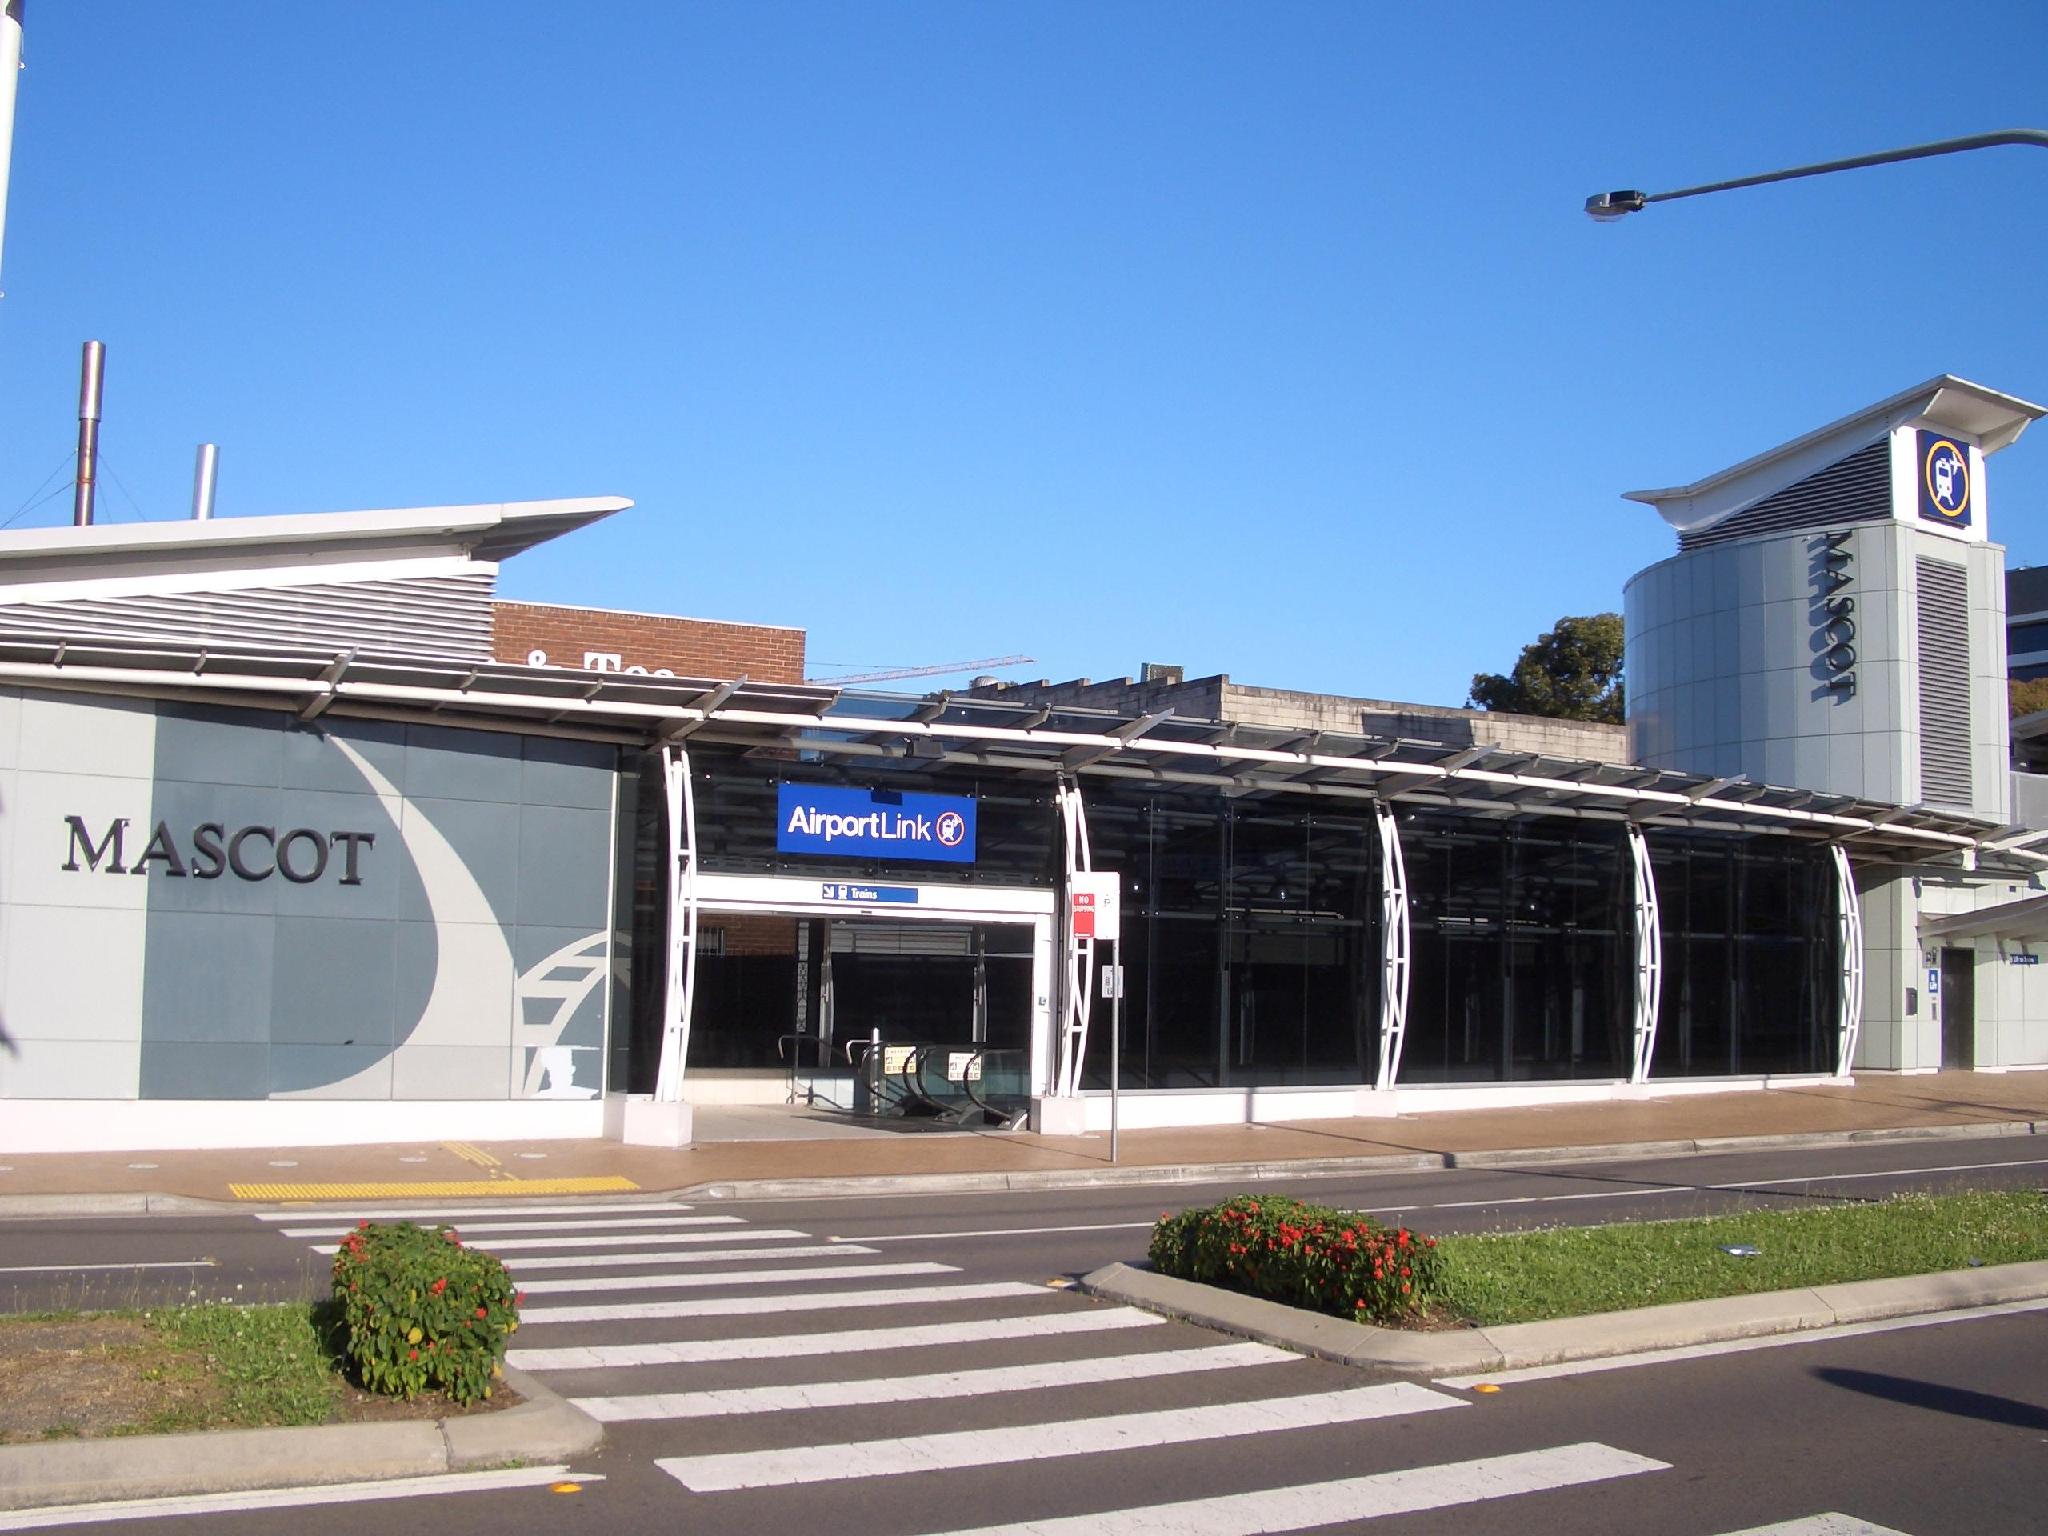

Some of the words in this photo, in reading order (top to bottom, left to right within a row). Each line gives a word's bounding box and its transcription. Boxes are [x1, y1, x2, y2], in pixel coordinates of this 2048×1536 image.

[1825, 530, 1856, 697] MASCOT
[61, 814, 375, 886] MASCOT
[788, 805, 932, 842] AirportLink
[851, 887, 878, 899] Trains
